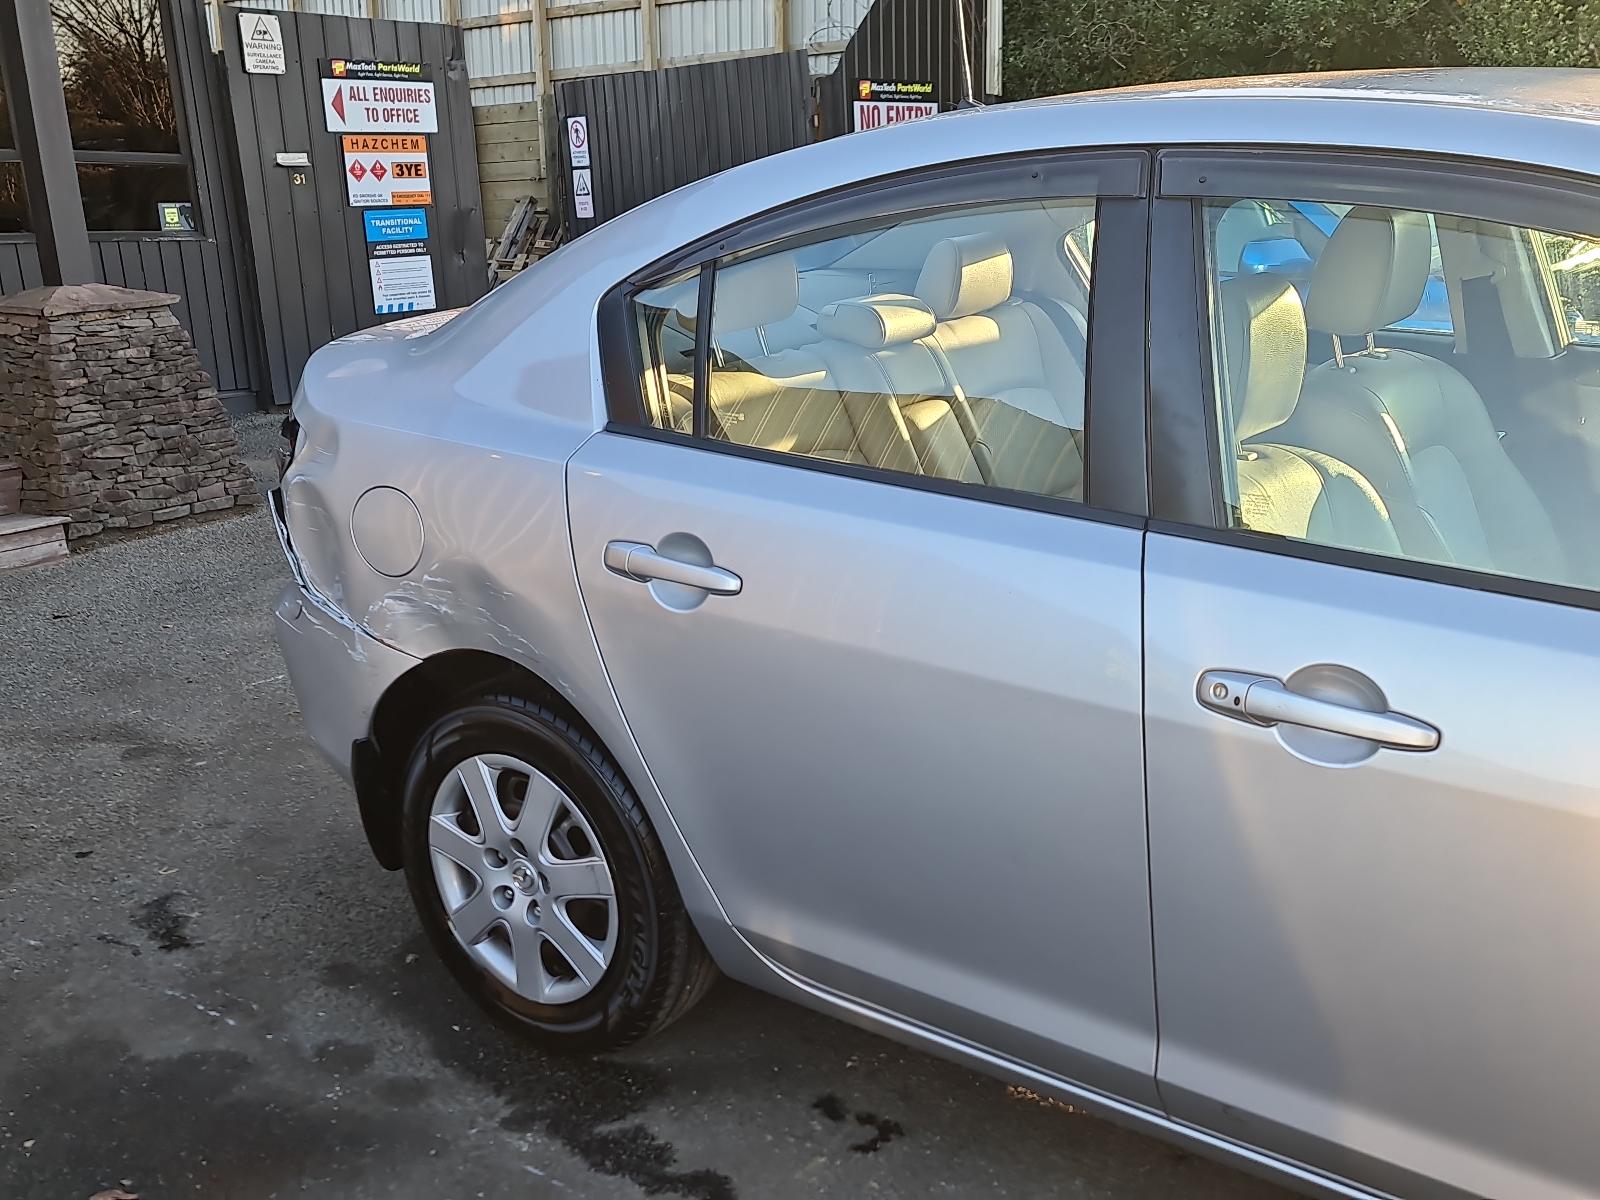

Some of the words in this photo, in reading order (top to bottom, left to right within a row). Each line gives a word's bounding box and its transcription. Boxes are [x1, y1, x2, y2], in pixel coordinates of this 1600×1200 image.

[245, 42, 282, 50] WARNING
[377, 63, 420, 73] PartsWorld
[896, 83, 933, 93] PartsWorld
[349, 86, 370, 102] ALL
[372, 87, 431, 104] ENQUIRIES
[364, 107, 380, 123] TO
[382, 107, 420, 123] OFFICE
[860, 104, 881, 131] NO
[350, 138, 420, 150] HAZCHEM
[395, 163, 423, 177] 3YE
[293, 173, 306, 185] 31
[371, 217, 423, 227] TRANSITIONAL
[382, 226, 413, 235] FACILITY
